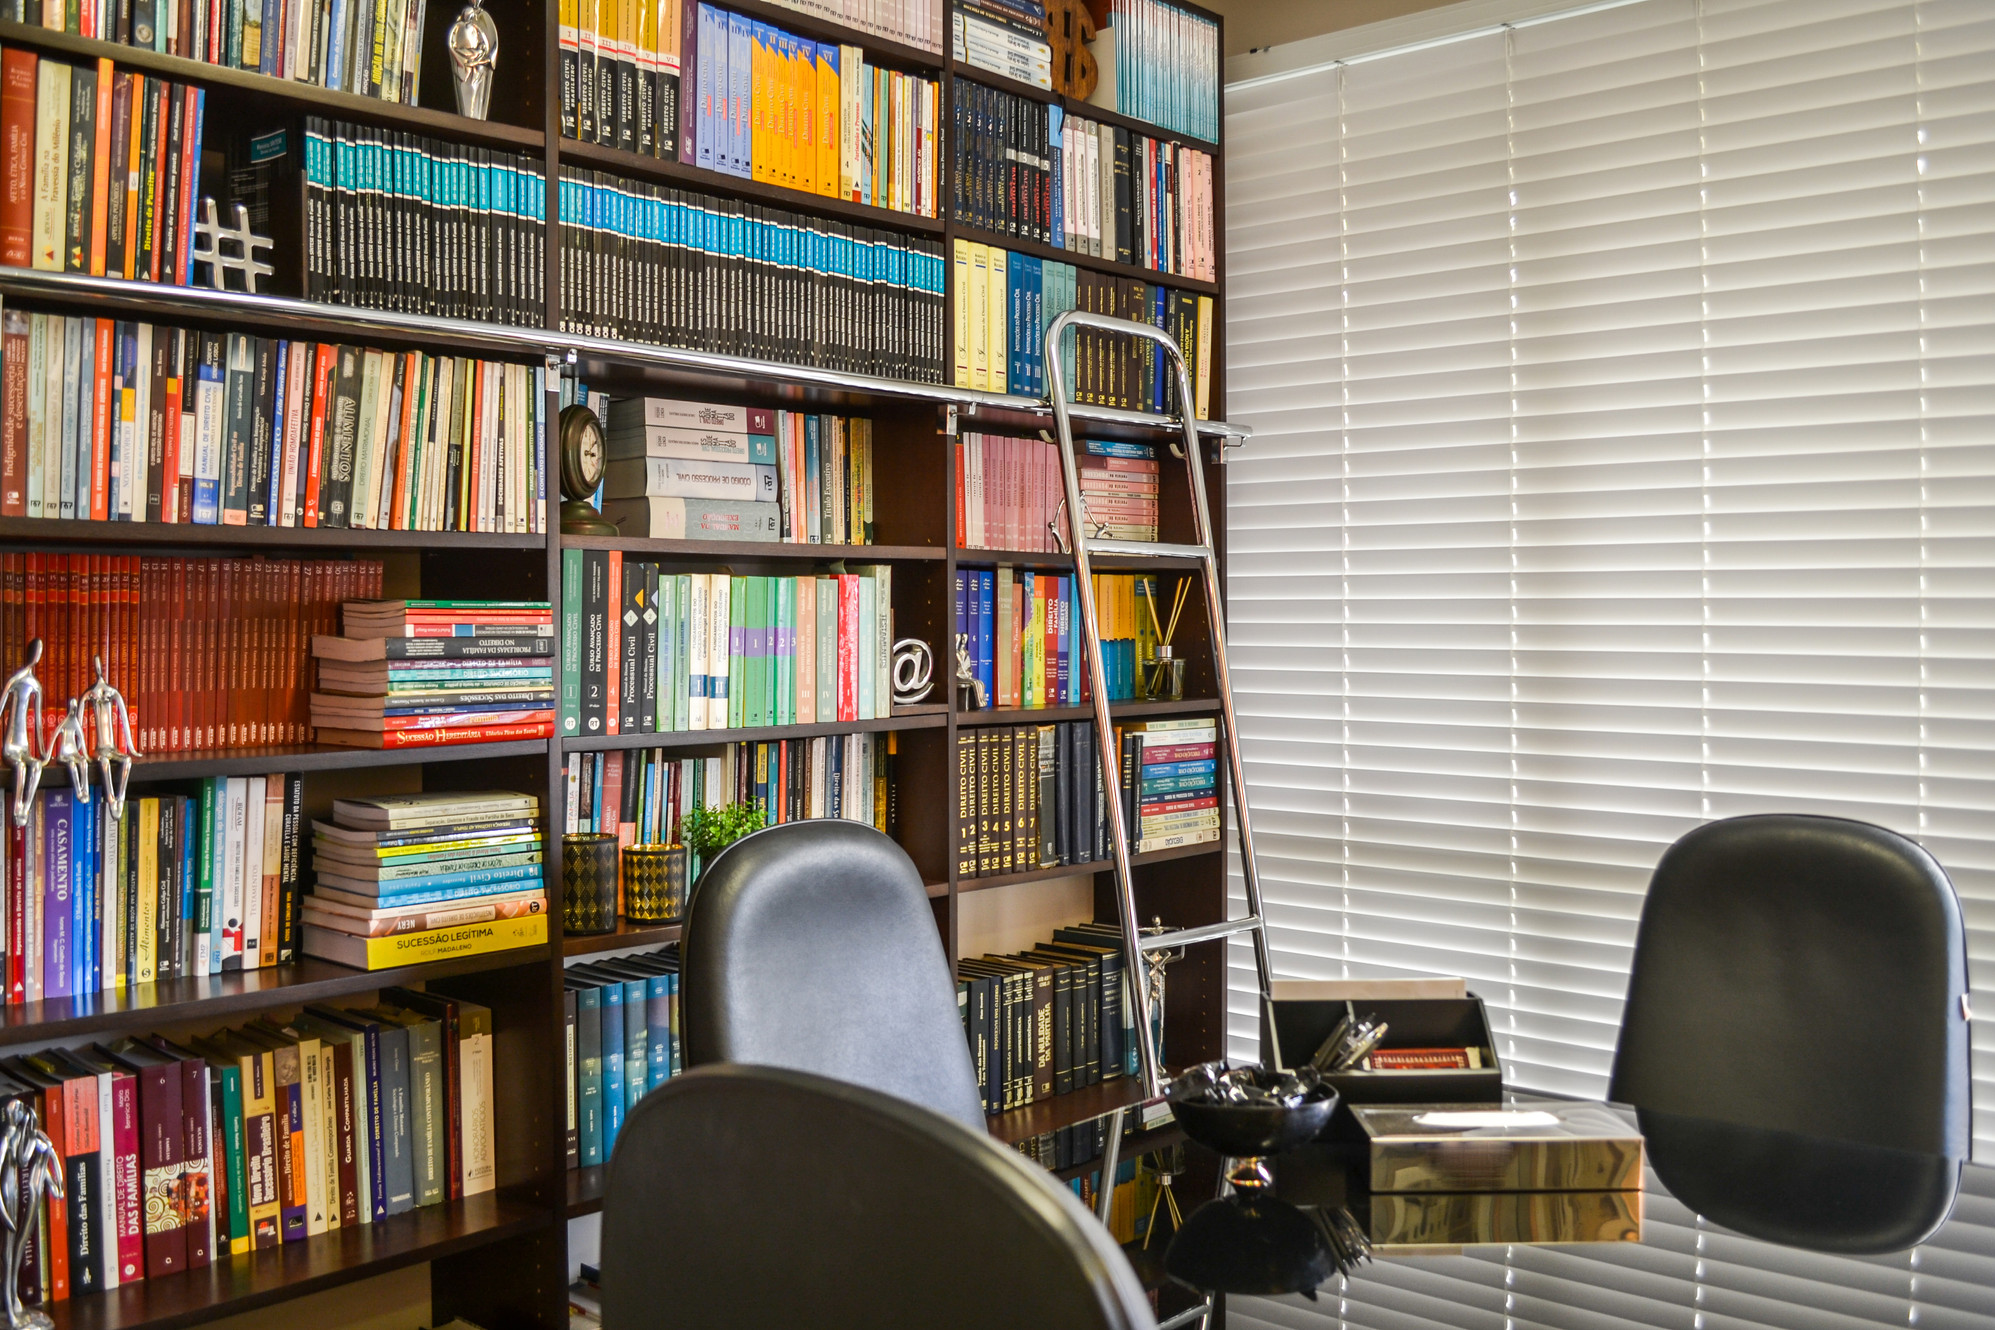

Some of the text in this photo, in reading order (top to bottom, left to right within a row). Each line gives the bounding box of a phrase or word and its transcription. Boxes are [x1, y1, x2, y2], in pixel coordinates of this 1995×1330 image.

[10, 125, 19, 154] FAMÍLIA
[52, 152, 60, 163] do
[41, 163, 50, 194] Família
[51, 165, 60, 202] Travessia
[170, 175, 176, 186] em
[168, 188, 176, 215] Família
[168, 217, 174, 226] de
[14, 366, 25, 421] deserdação
[5, 365, 16, 477] Indignidade sucessória
[201, 386, 212, 474] MANUAL DE DIREITO CIVIL
[287, 409, 299, 475] UNIÃO HOMOAFETIVA
[339, 397, 355, 482] ALIMENTOS
[271, 427, 282, 505] TESTAMENTO
[538, 452, 545, 460] DE
[823, 463, 832, 519] Título Executivo
[628, 636, 636, 656] Civil
[595, 664, 601, 672] DE
[647, 655, 655, 699] Processual
[970, 824, 976, 835] 2
[982, 821, 988, 831] 3
[993, 822, 999, 832] 4
[1004, 821, 1010, 831] 5
[1018, 818, 1024, 828] 6
[1030, 818, 1035, 828] 7
[57, 819, 68, 901] CASAMENTO
[470, 868, 524, 882] Direito Civil
[397, 927, 494, 950] SUCESSÃO LEGÍTIMA
[437, 943, 472, 955] MADALENO
[1037, 1008, 1046, 1068] DA NULIDADE
[1044, 1048, 1051, 1061] DA
[373, 1106, 379, 1114] DE
[281, 1114, 291, 1174] Direito de Família
[250, 1155, 263, 1204] Novo Direito
[77, 1162, 90, 1255] Direito das Famílias
[116, 1156, 127, 1237] MANUAL DE DIREITO
[125, 1154, 139, 1235] DAS FAMÍLIAS
